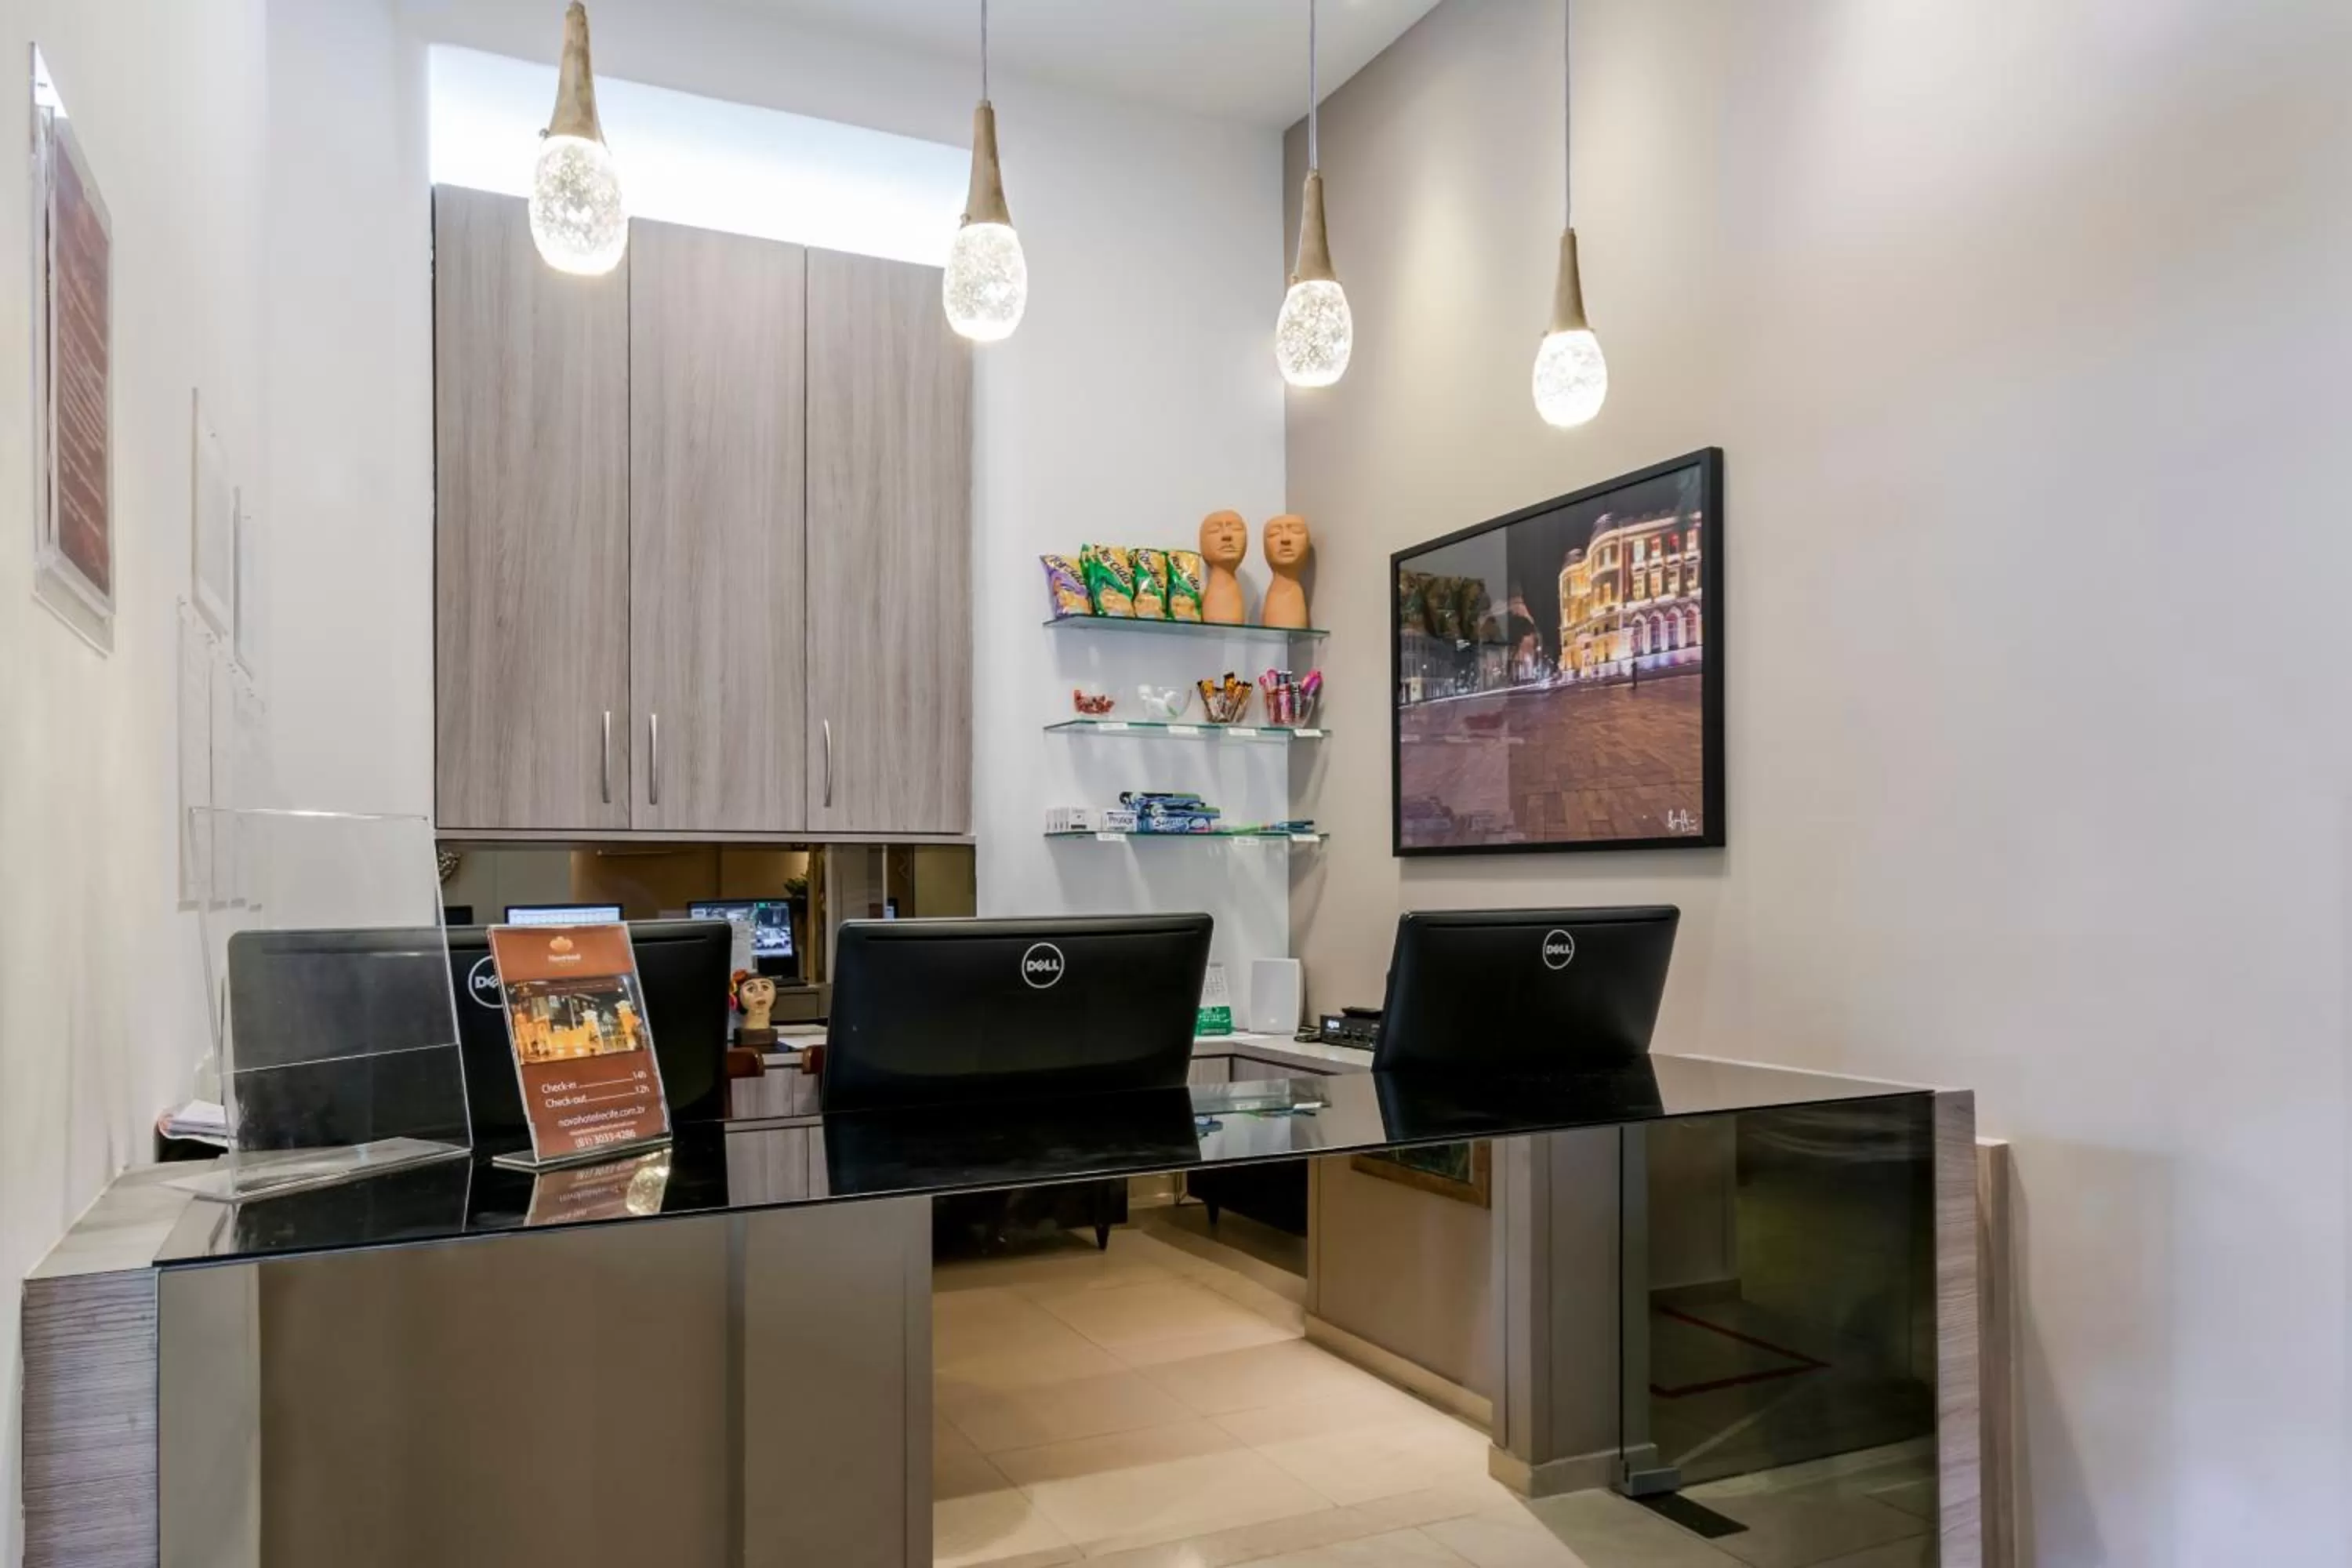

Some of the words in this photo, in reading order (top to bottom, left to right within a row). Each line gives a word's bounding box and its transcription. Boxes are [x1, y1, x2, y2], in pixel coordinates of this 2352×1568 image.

[1547, 944, 1570, 954] DELL
[1027, 959, 1059, 972] DELL
[475, 975, 499, 989] DE
[542, 1082, 577, 1094] Check-in
[545, 1094, 587, 1108] Check-out
